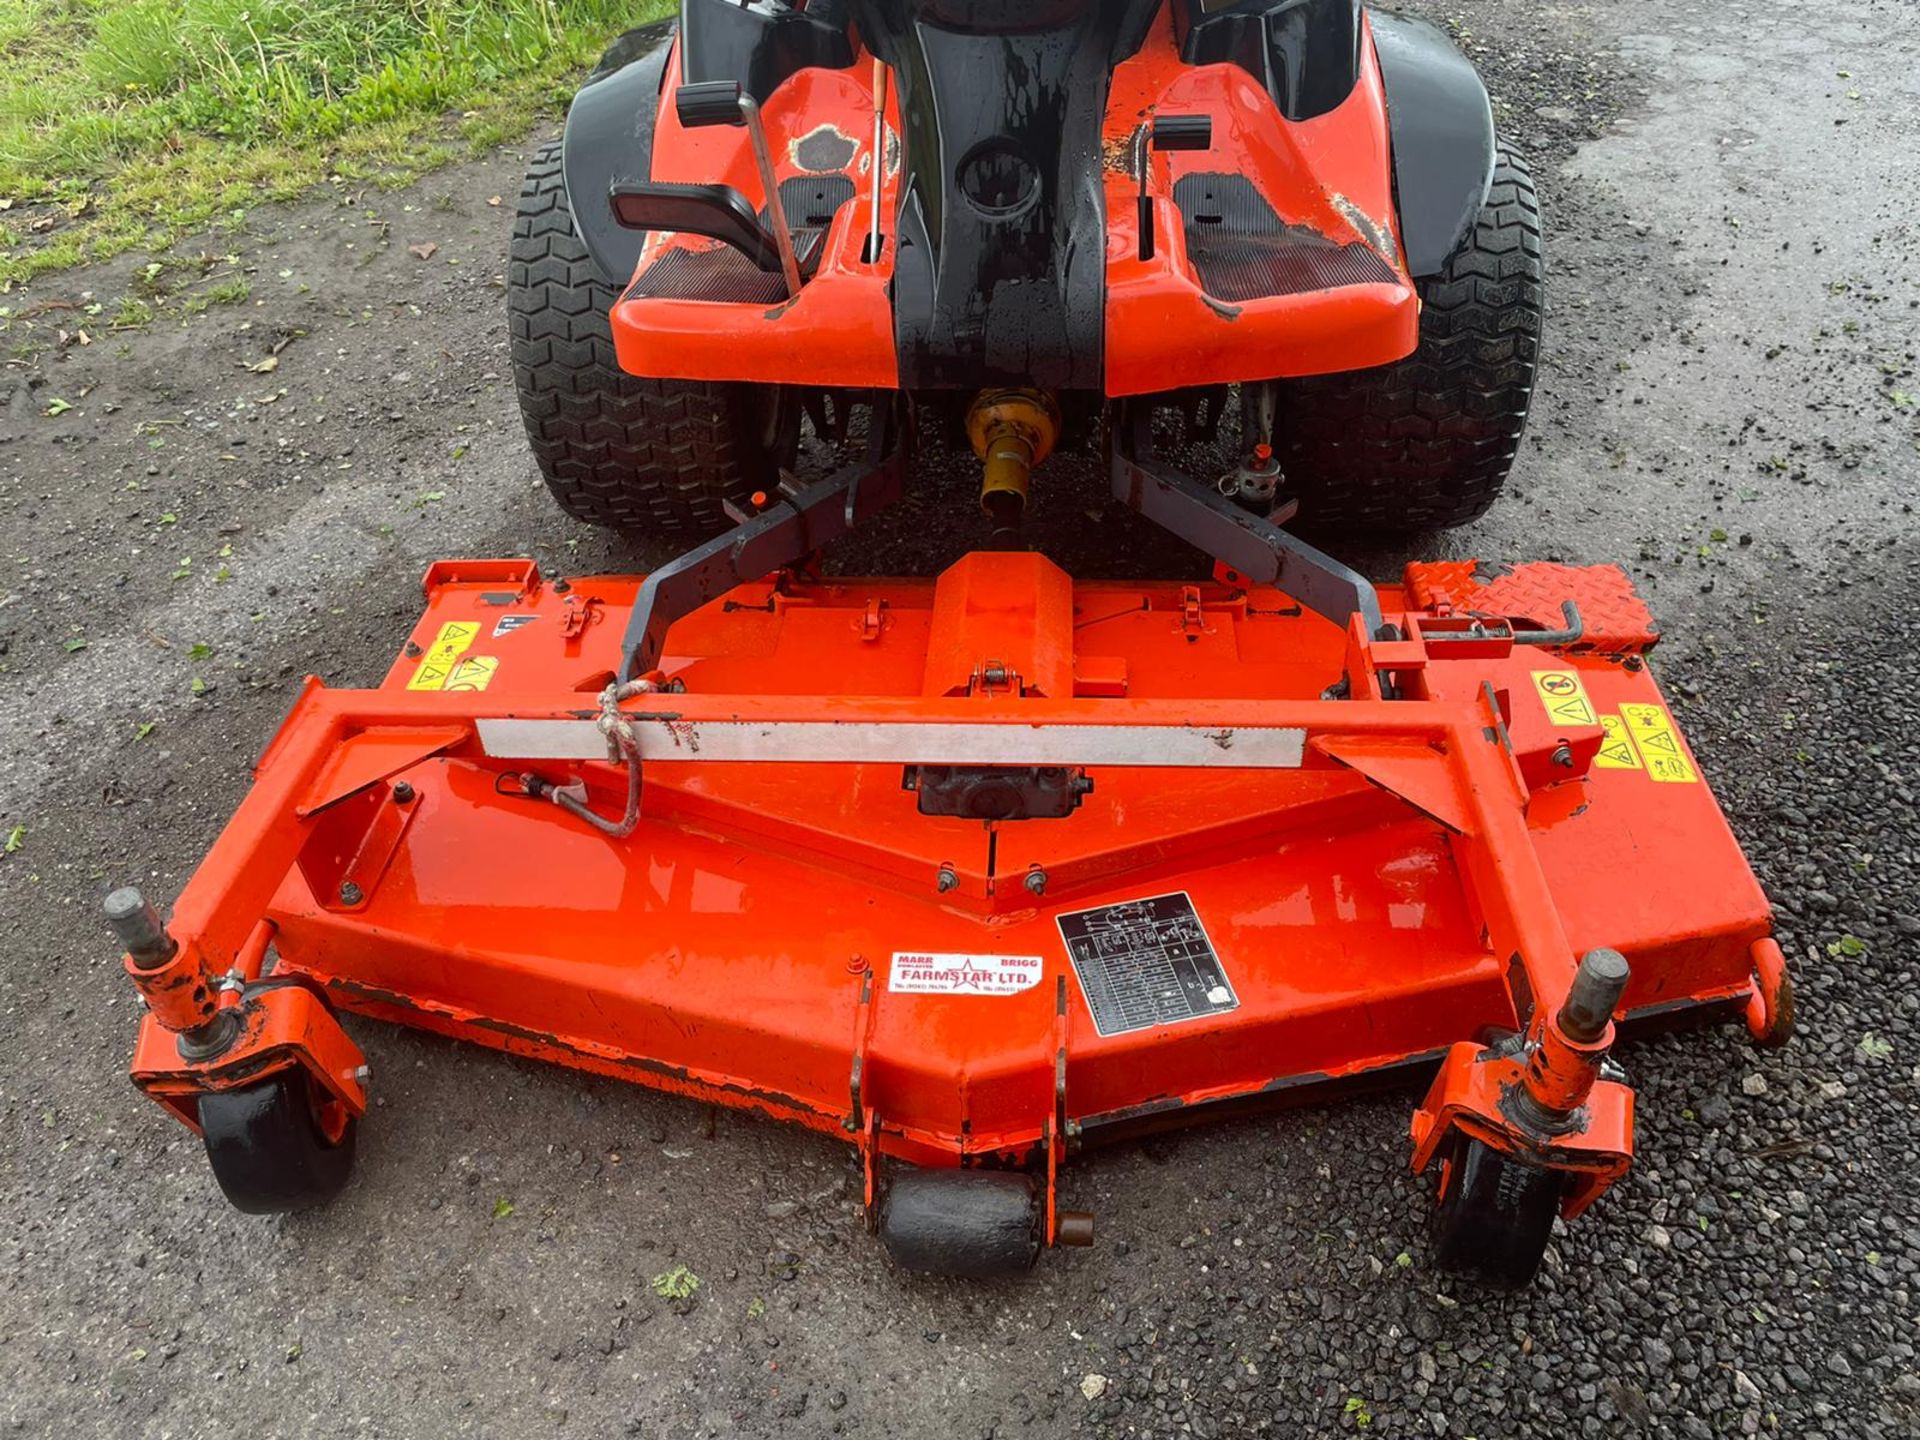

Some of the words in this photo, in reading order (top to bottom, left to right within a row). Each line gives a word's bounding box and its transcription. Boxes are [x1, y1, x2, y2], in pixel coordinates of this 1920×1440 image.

[898, 955, 934, 964] MARR
[1000, 959, 1039, 967] BRIGG
[901, 970, 993, 983] FARMSTAR
[998, 973, 1033, 985] LTD.
